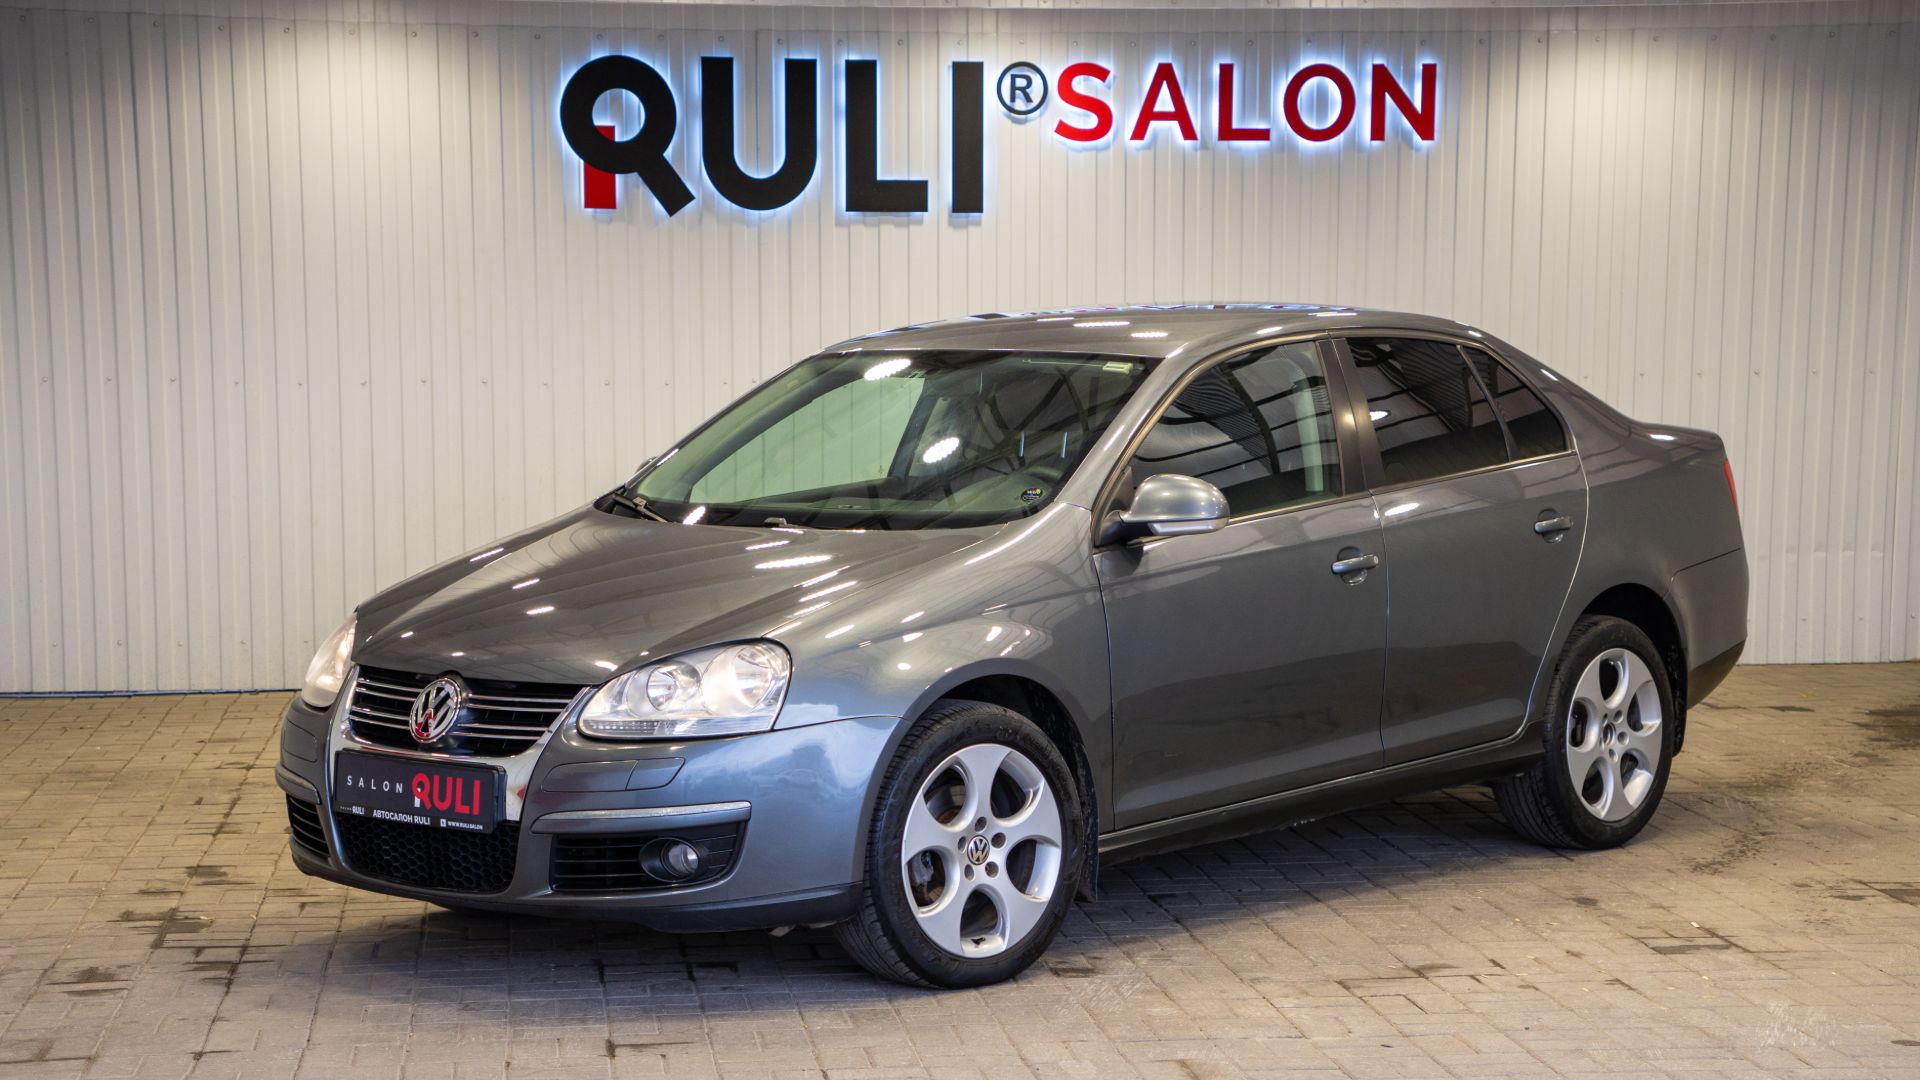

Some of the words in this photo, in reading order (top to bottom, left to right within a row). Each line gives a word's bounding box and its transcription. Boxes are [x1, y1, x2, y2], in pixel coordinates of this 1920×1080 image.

[1054, 61, 1437, 142] SALON
[346, 775, 403, 794] SALON
[372, 809, 413, 824] АВТОСАЛОН
[414, 815, 431, 826] RULI
